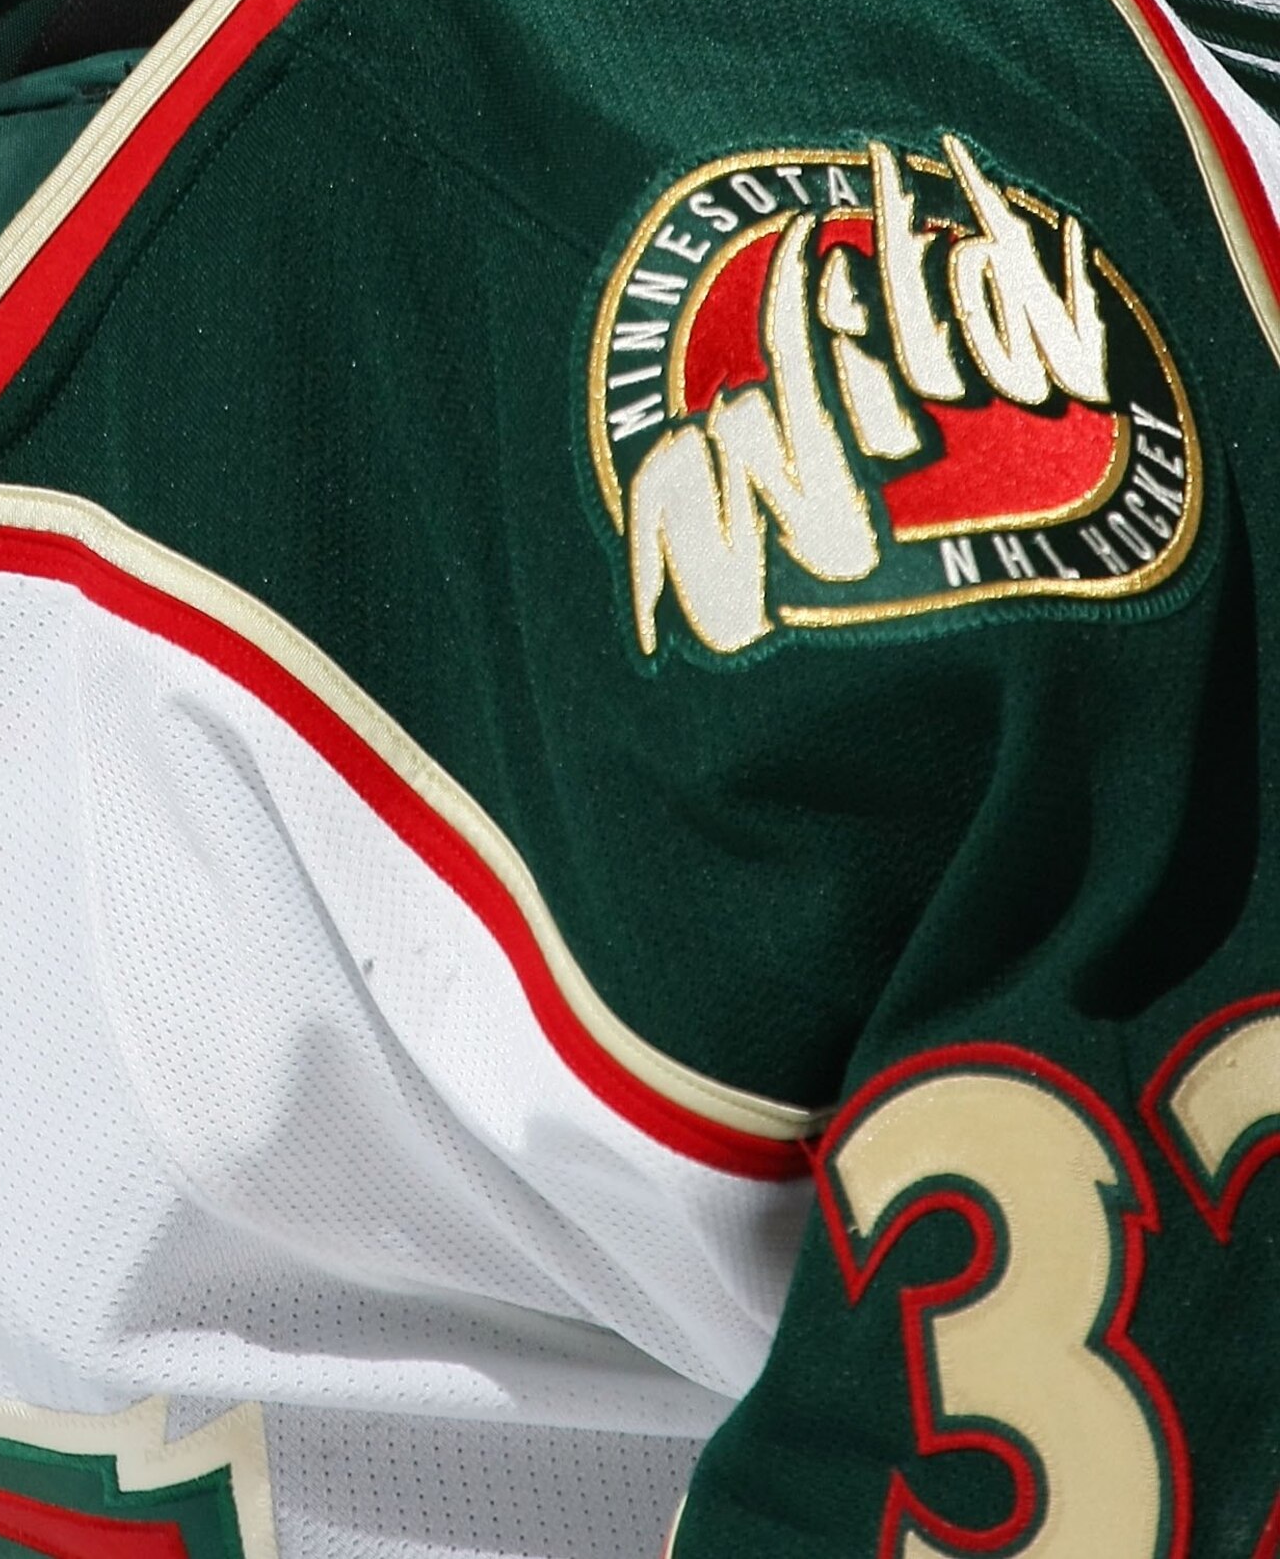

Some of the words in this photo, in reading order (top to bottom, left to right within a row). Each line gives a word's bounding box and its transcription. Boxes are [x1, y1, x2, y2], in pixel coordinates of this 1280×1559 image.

[607, 165, 861, 443] MINNESOTA
[630, 133, 1110, 654] Wild
[939, 532, 1080, 587] NHL
[1094, 401, 1184, 576] HOCKEY
[815, 990, 1280, 1559] 3
